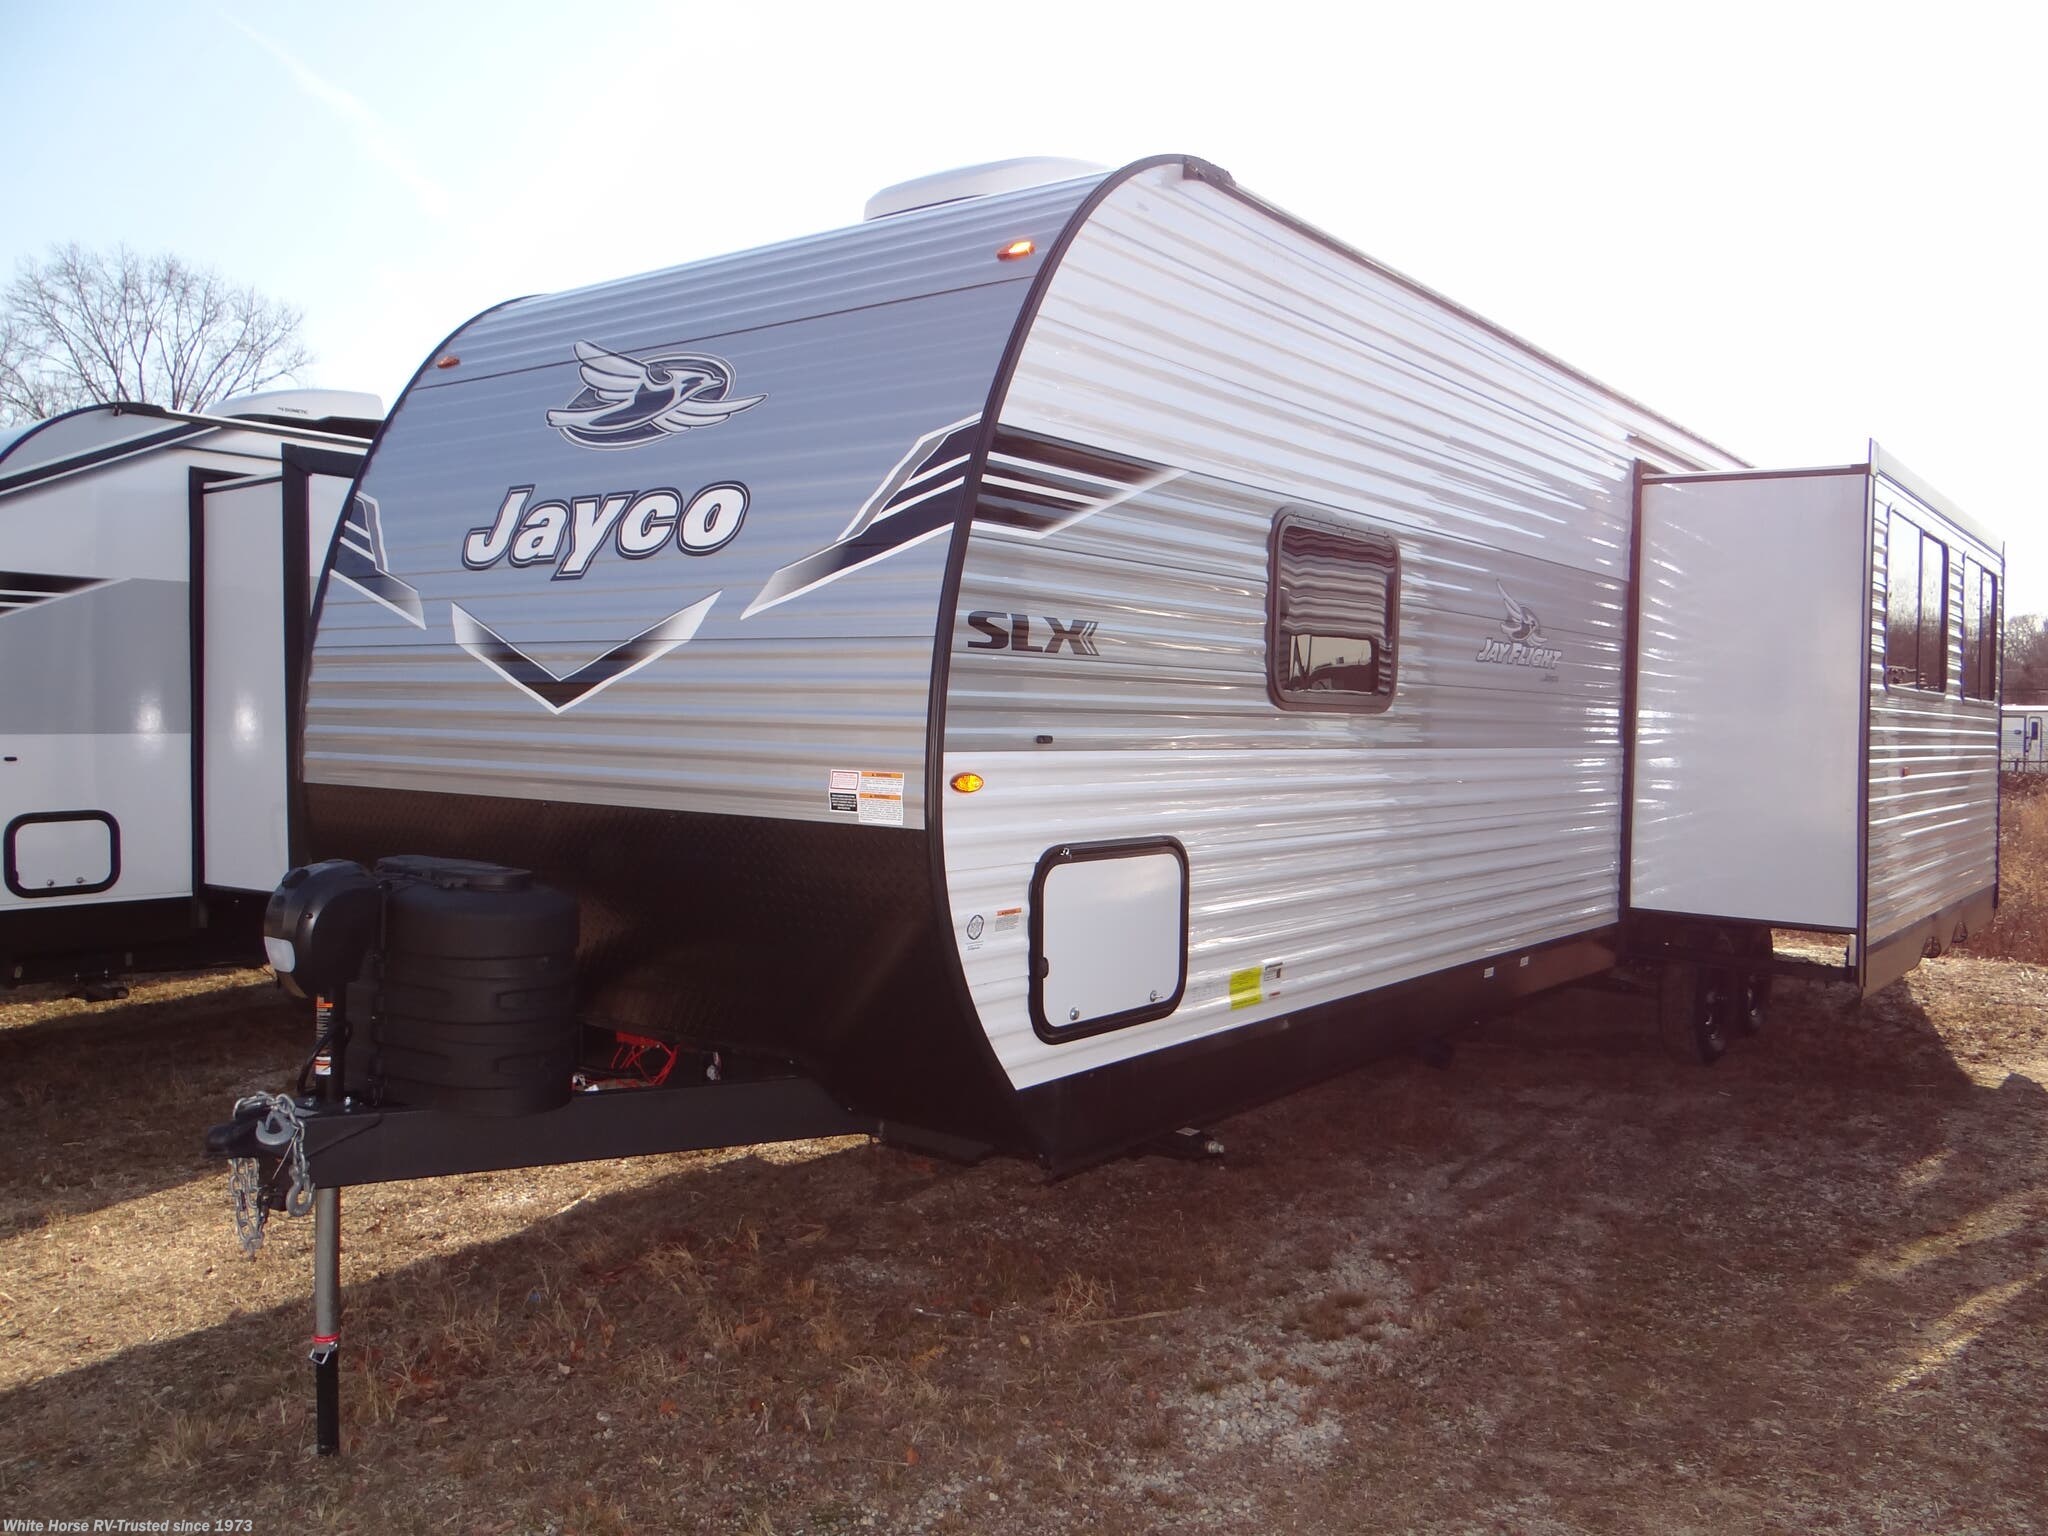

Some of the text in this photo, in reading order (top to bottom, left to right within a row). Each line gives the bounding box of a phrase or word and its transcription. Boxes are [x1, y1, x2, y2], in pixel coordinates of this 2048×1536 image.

[462, 480, 751, 581] Jayco
[967, 610, 1100, 656] SLX
[1476, 637, 1562, 670] JAY FLIGHT
